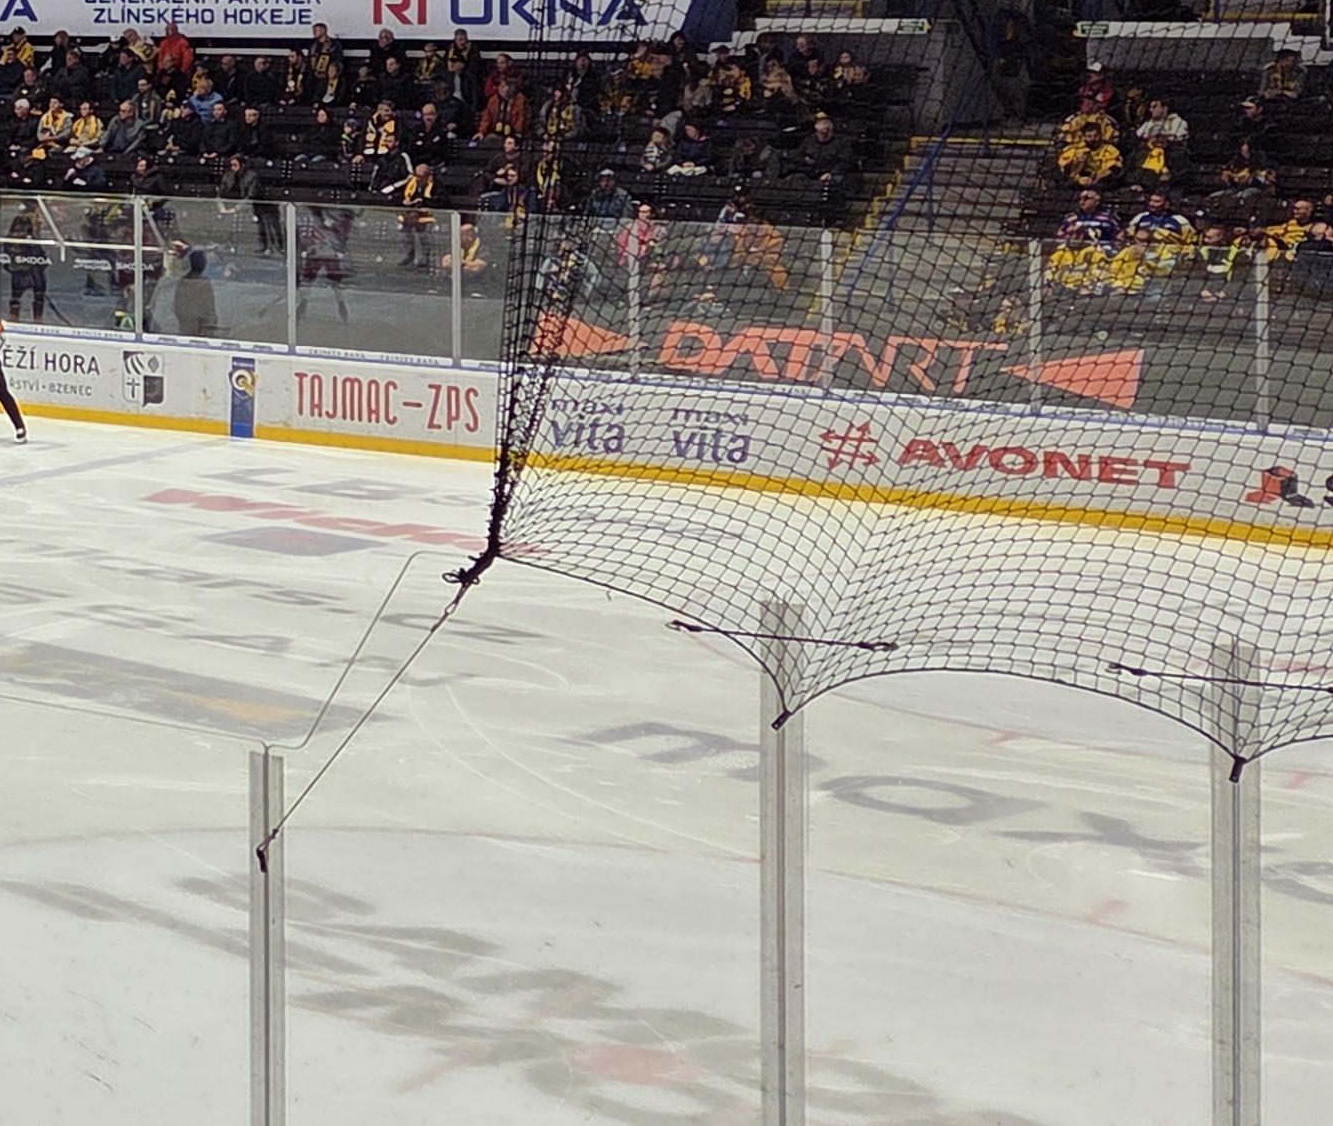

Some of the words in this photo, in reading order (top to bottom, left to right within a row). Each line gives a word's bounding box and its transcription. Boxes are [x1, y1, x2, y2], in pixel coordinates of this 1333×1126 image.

[93, 3, 216, 25] ZLÍNSKÉHO
[224, 7, 313, 25] HOKEJE
[45, 351, 101, 376] HORA
[46, 383, 93, 397] BZENEC
[550, 418, 626, 454] vita
[671, 426, 753, 465] vita
[897, 436, 1192, 491] AVONET
